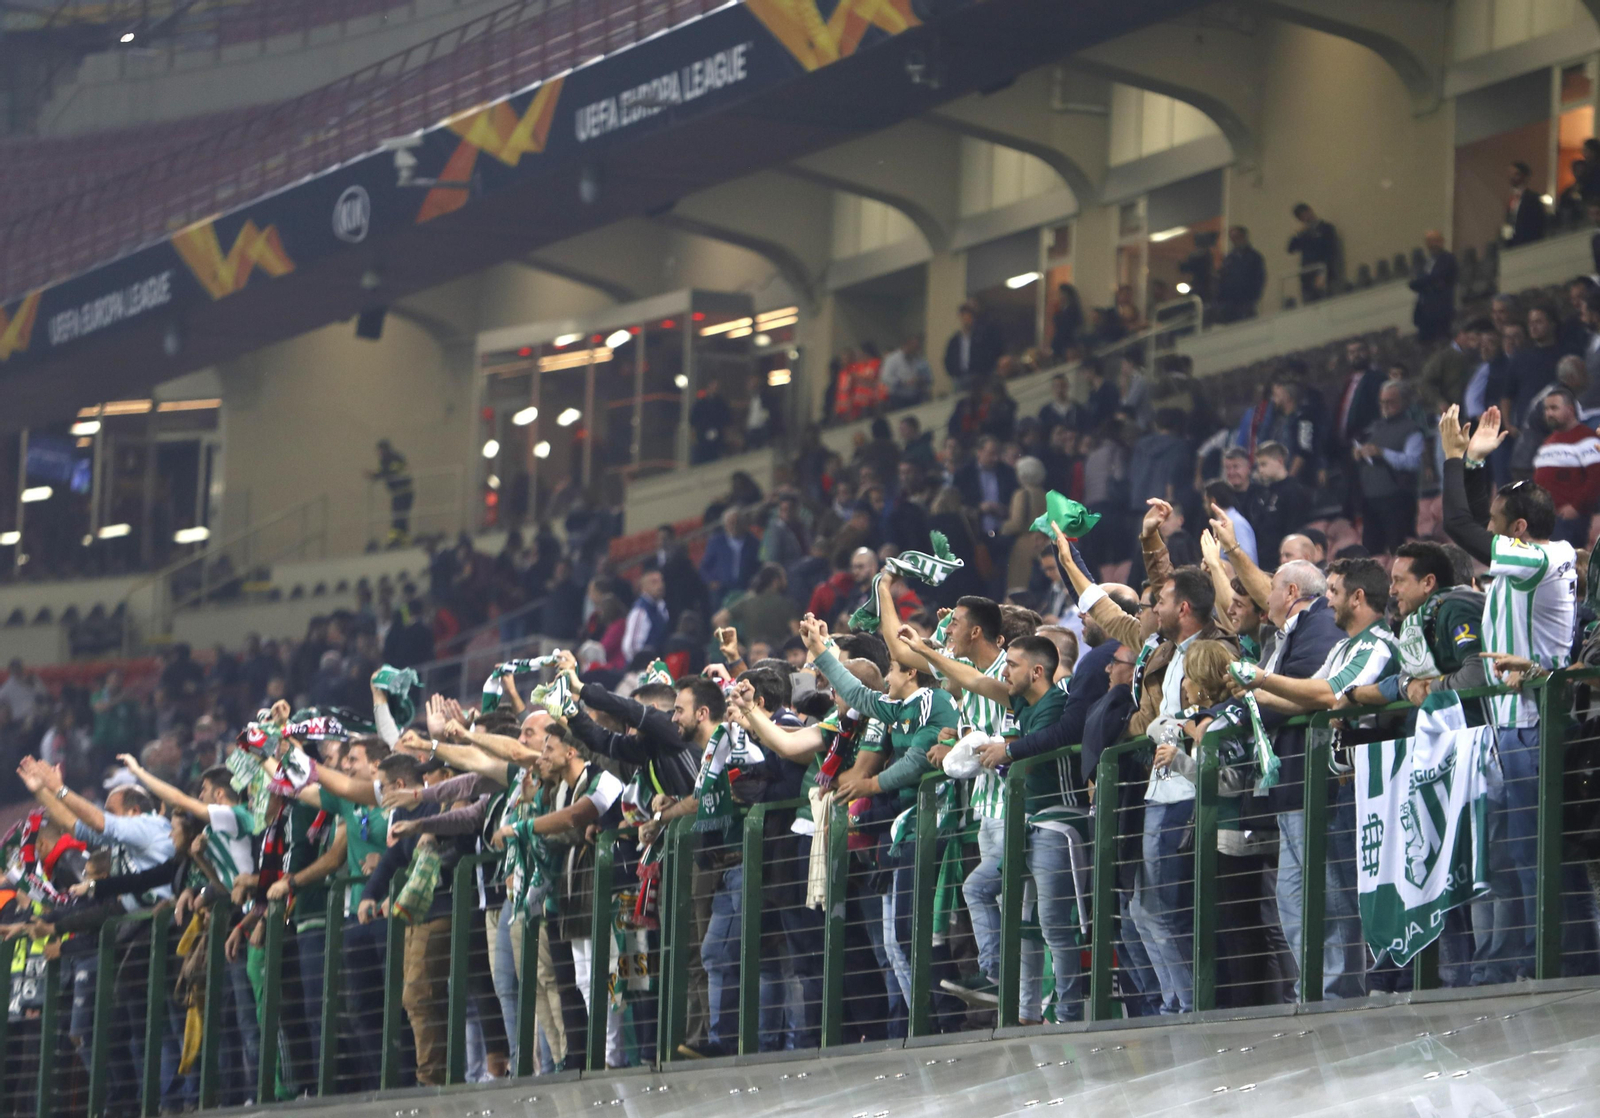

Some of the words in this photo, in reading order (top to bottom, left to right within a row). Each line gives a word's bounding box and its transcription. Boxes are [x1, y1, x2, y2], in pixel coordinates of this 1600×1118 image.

[574, 97, 619, 142] UEFA
[619, 71, 682, 126] EUROPA
[682, 44, 748, 101] LEAGUE
[49, 308, 79, 346] UEFA
[80, 291, 123, 336] EUROPA
[124, 270, 172, 318] LEAGUE
